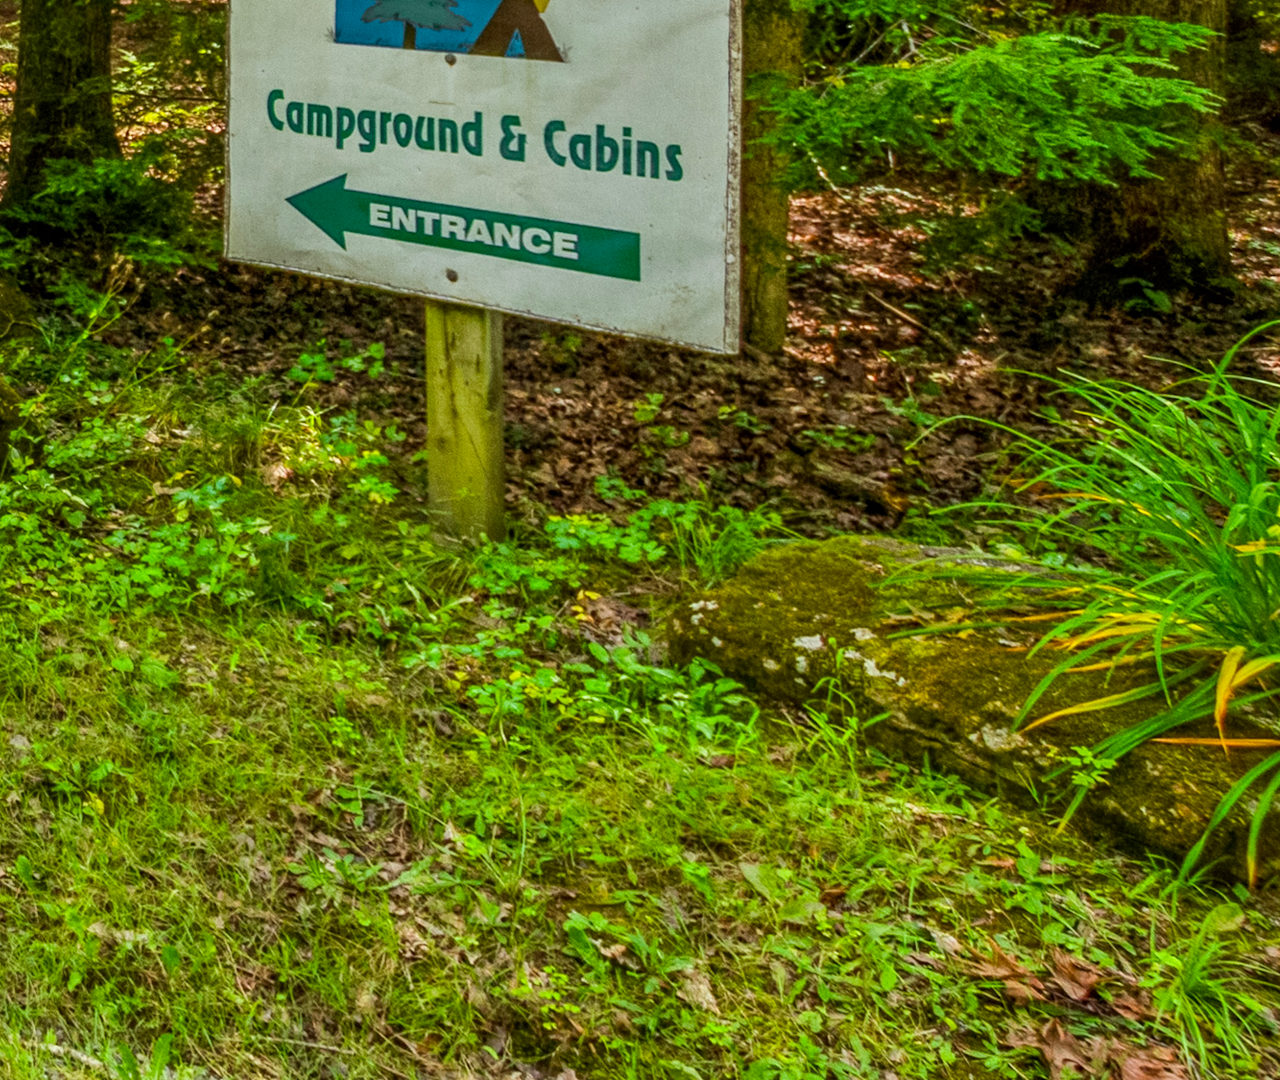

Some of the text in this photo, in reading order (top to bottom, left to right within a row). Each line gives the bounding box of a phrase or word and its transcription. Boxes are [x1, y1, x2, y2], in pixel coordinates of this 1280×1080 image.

[266, 88, 684, 181] Campground & Cabins
[367, 201, 579, 260] ENTRANCE
